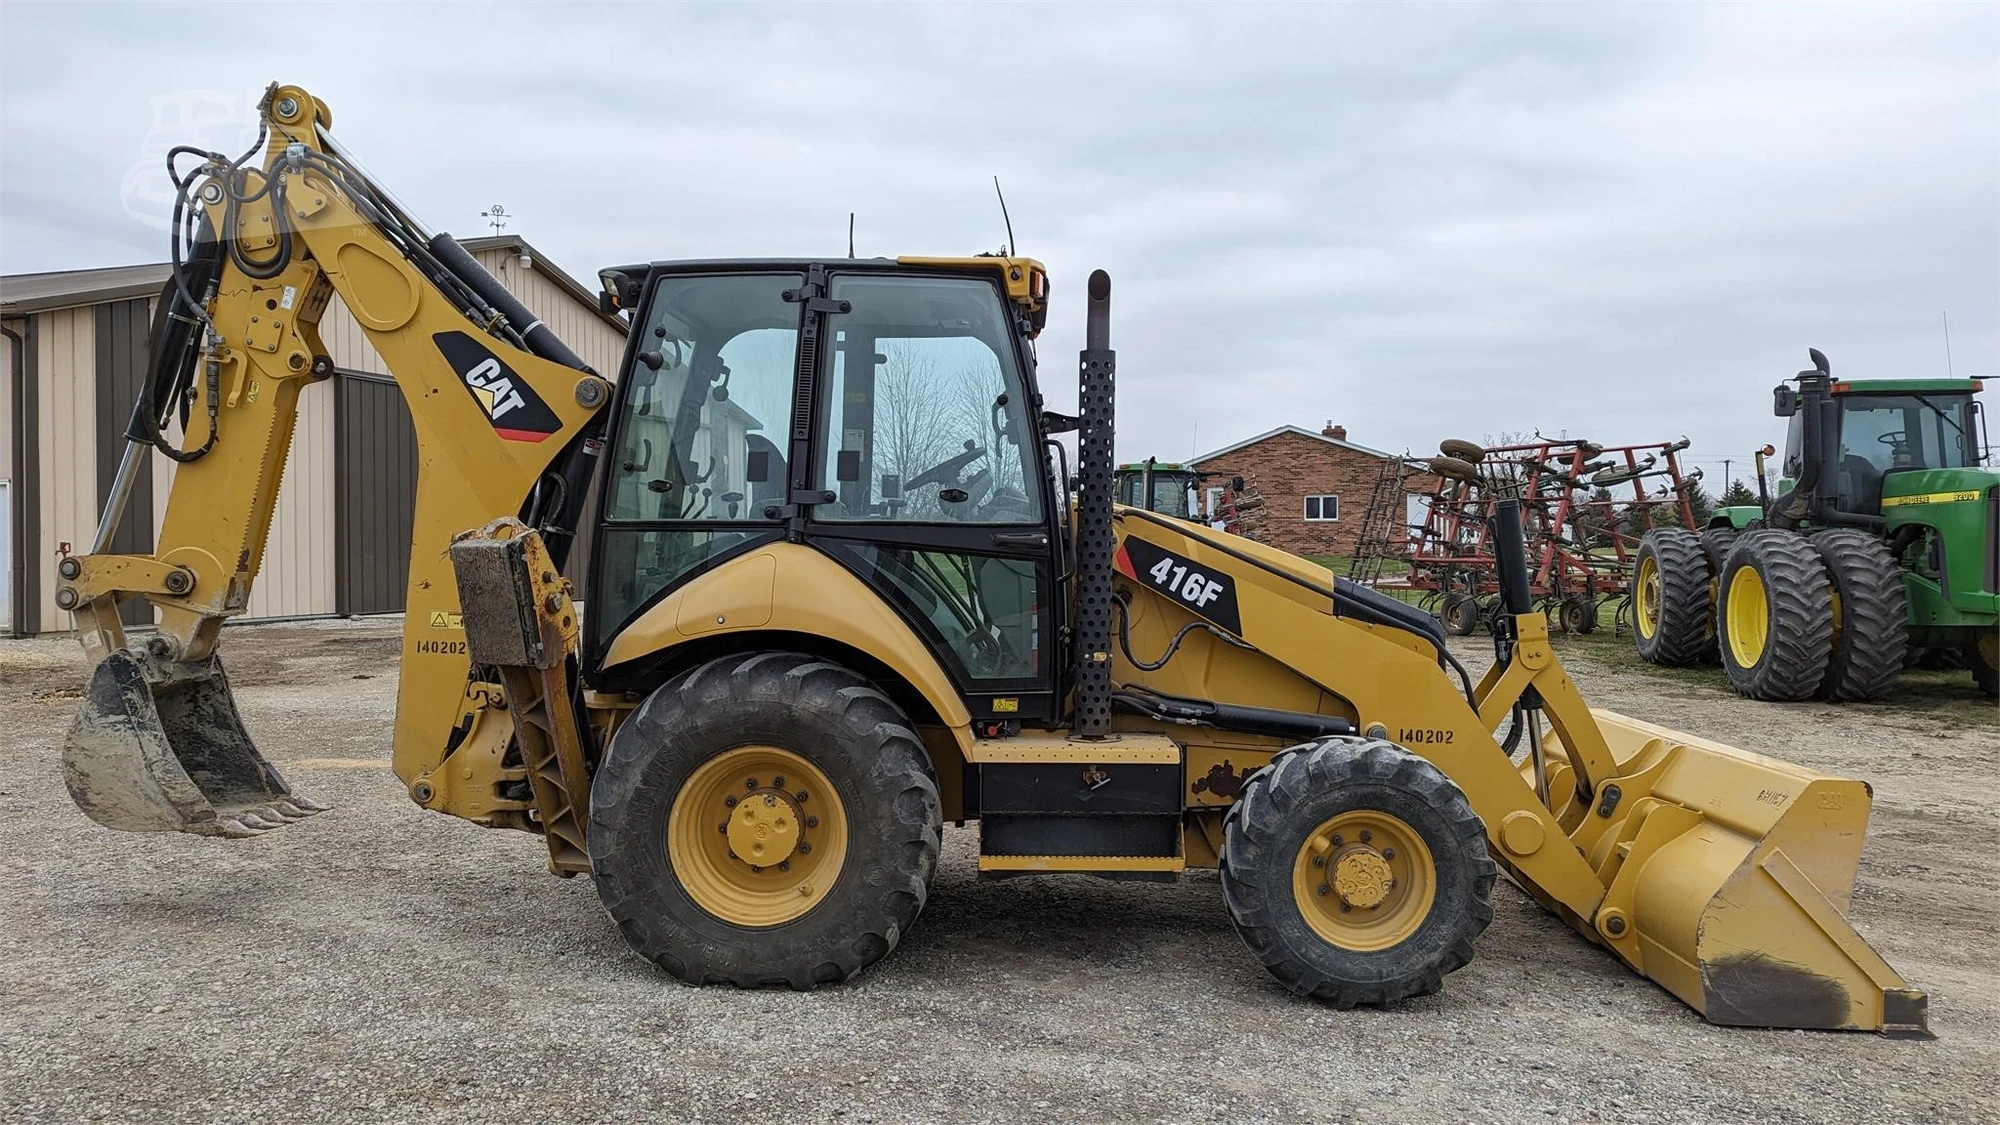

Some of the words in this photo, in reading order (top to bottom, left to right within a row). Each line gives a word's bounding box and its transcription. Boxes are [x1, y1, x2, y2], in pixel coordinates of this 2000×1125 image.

[466, 358, 525, 420] CAT
[1149, 557, 1224, 608] 416F
[416, 640, 467, 655] 140202
[1399, 728, 1454, 744] 140202
